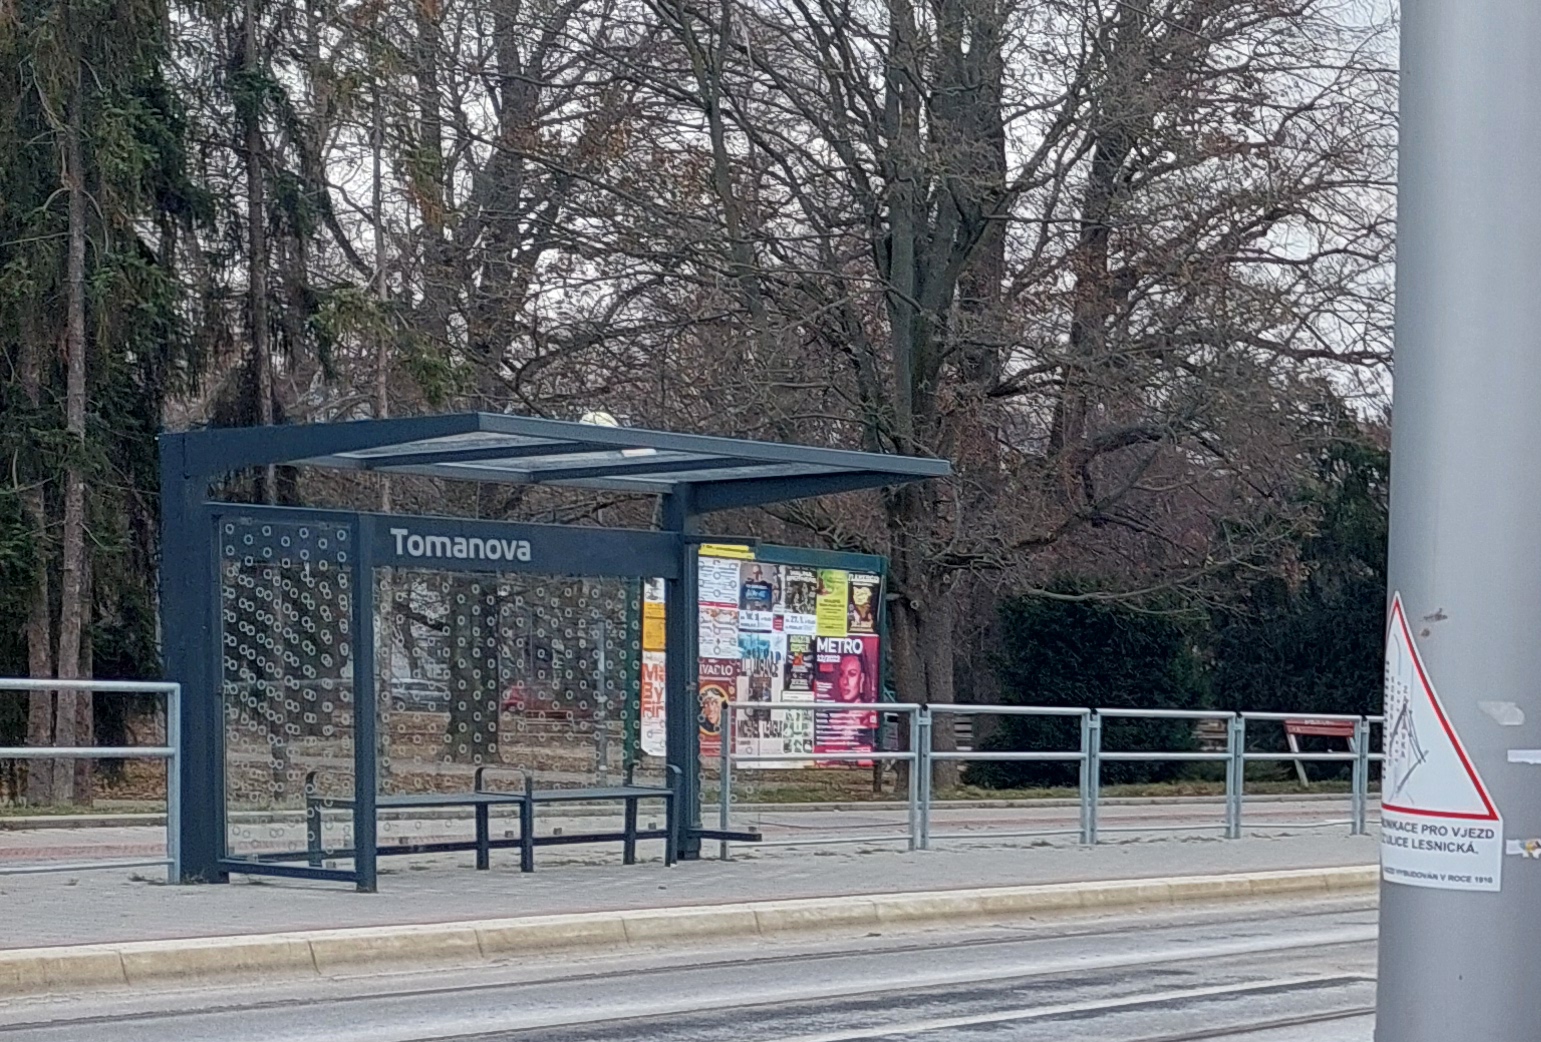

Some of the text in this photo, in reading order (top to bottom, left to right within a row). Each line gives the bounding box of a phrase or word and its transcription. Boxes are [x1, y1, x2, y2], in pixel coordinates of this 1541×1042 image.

[390, 528, 531, 561] Tomanova
[816, 637, 863, 655] METRO
[1421, 823, 1448, 837] PRO
[1451, 826, 1495, 839] VJEZD
[1448, 874, 1472, 883] ROCE
